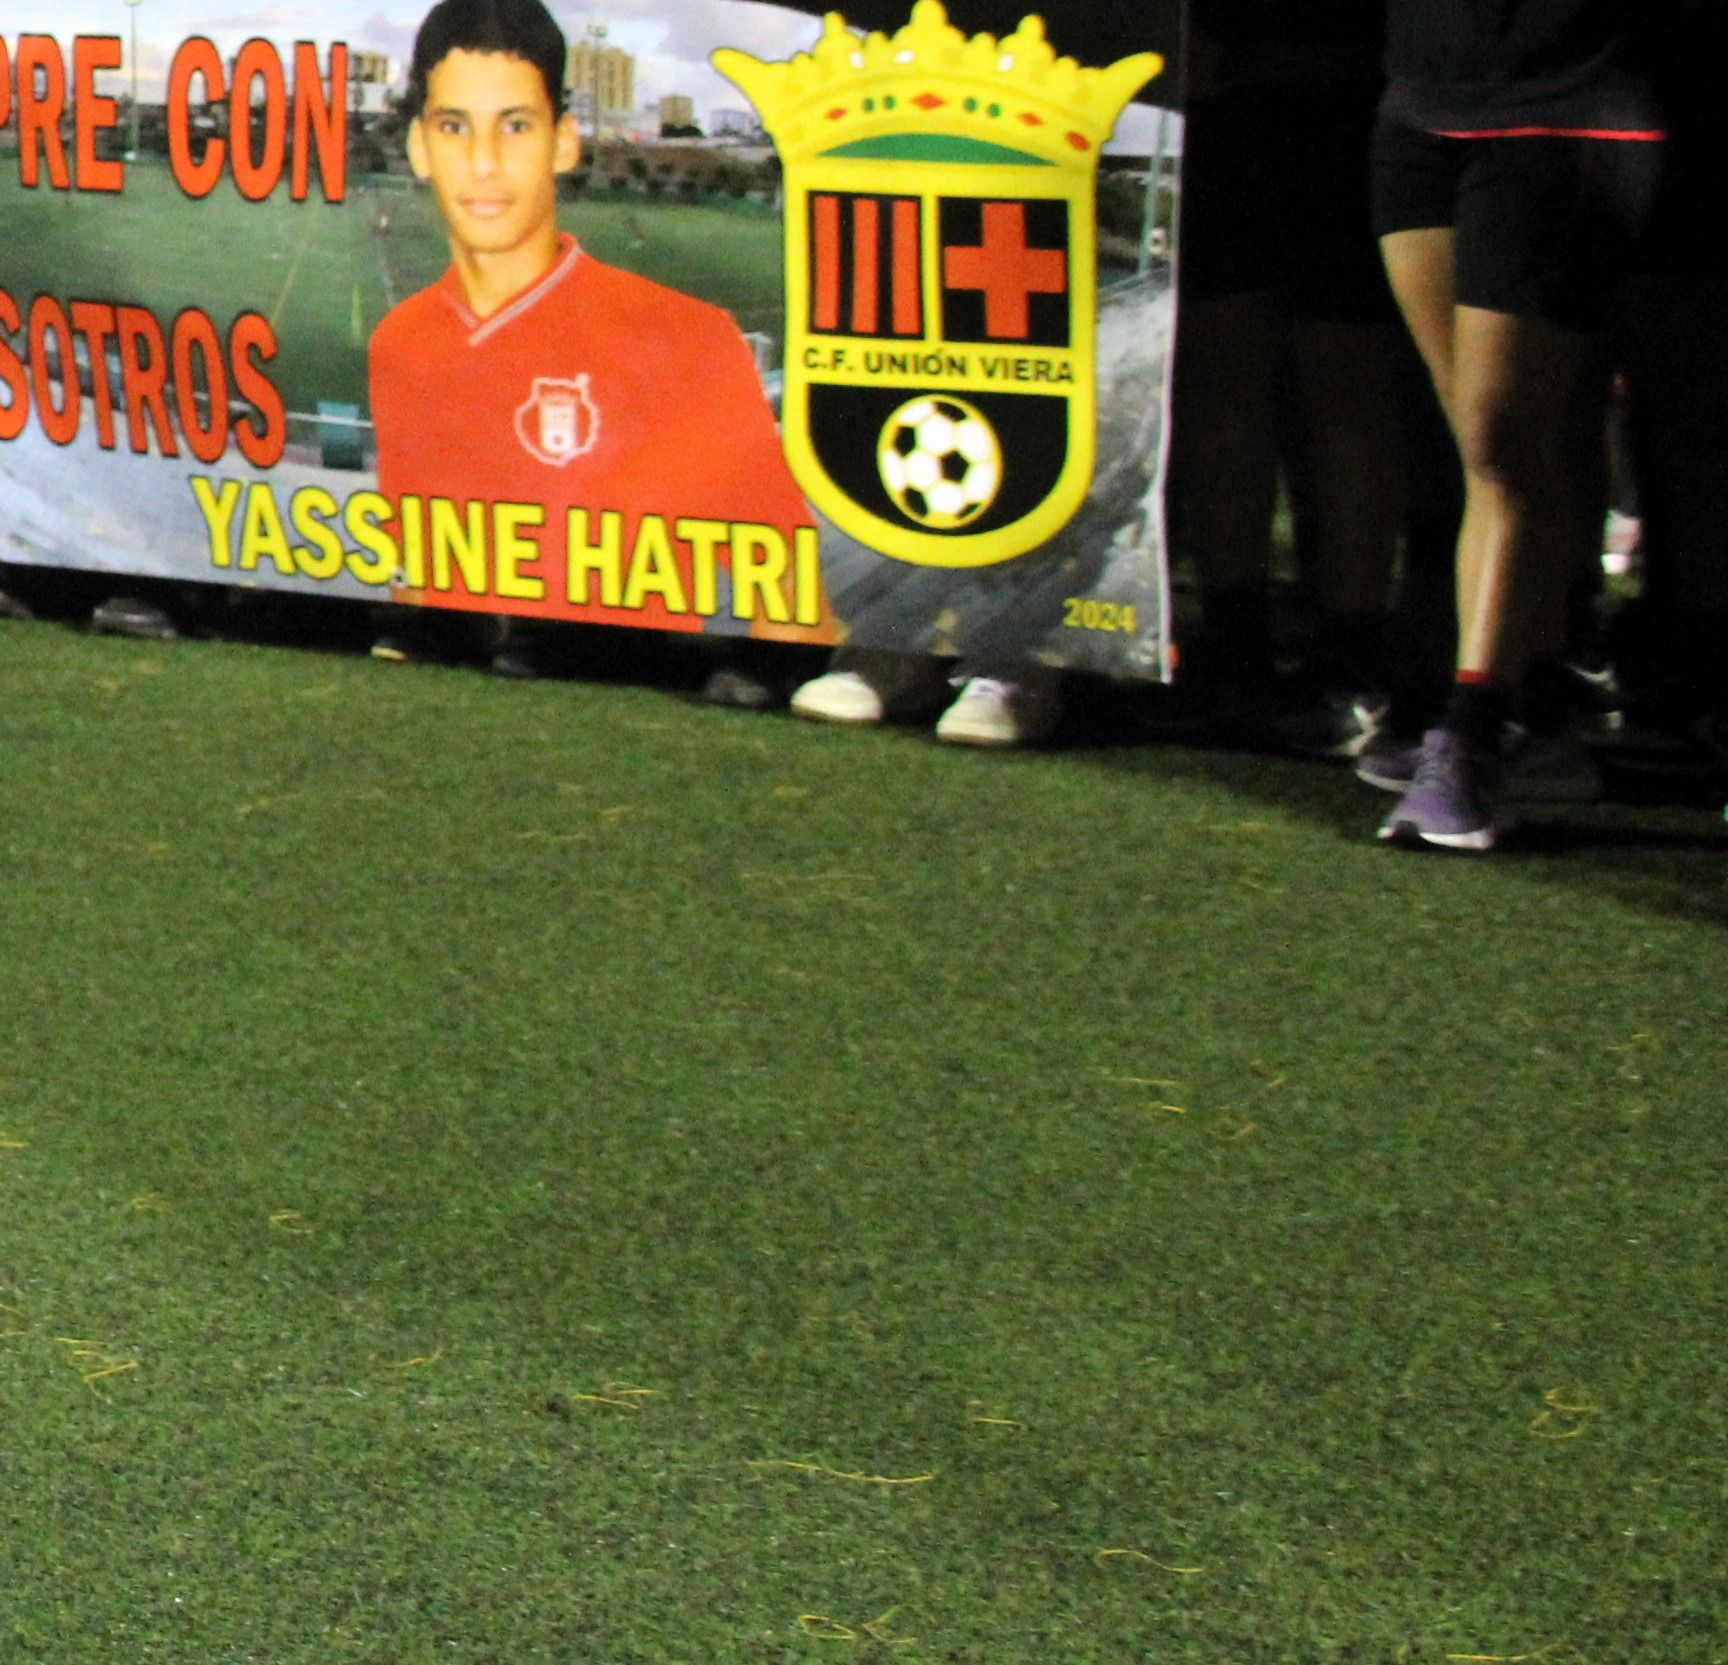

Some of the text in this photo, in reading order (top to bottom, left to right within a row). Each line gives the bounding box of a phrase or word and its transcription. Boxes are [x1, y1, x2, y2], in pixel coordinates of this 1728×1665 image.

[167, 34, 348, 204] CON
[801, 346, 1075, 385] C.F. UNIÓN VIERA
[189, 473, 821, 628] YASSINE HATRI
[1061, 596, 1139, 634] 2024
